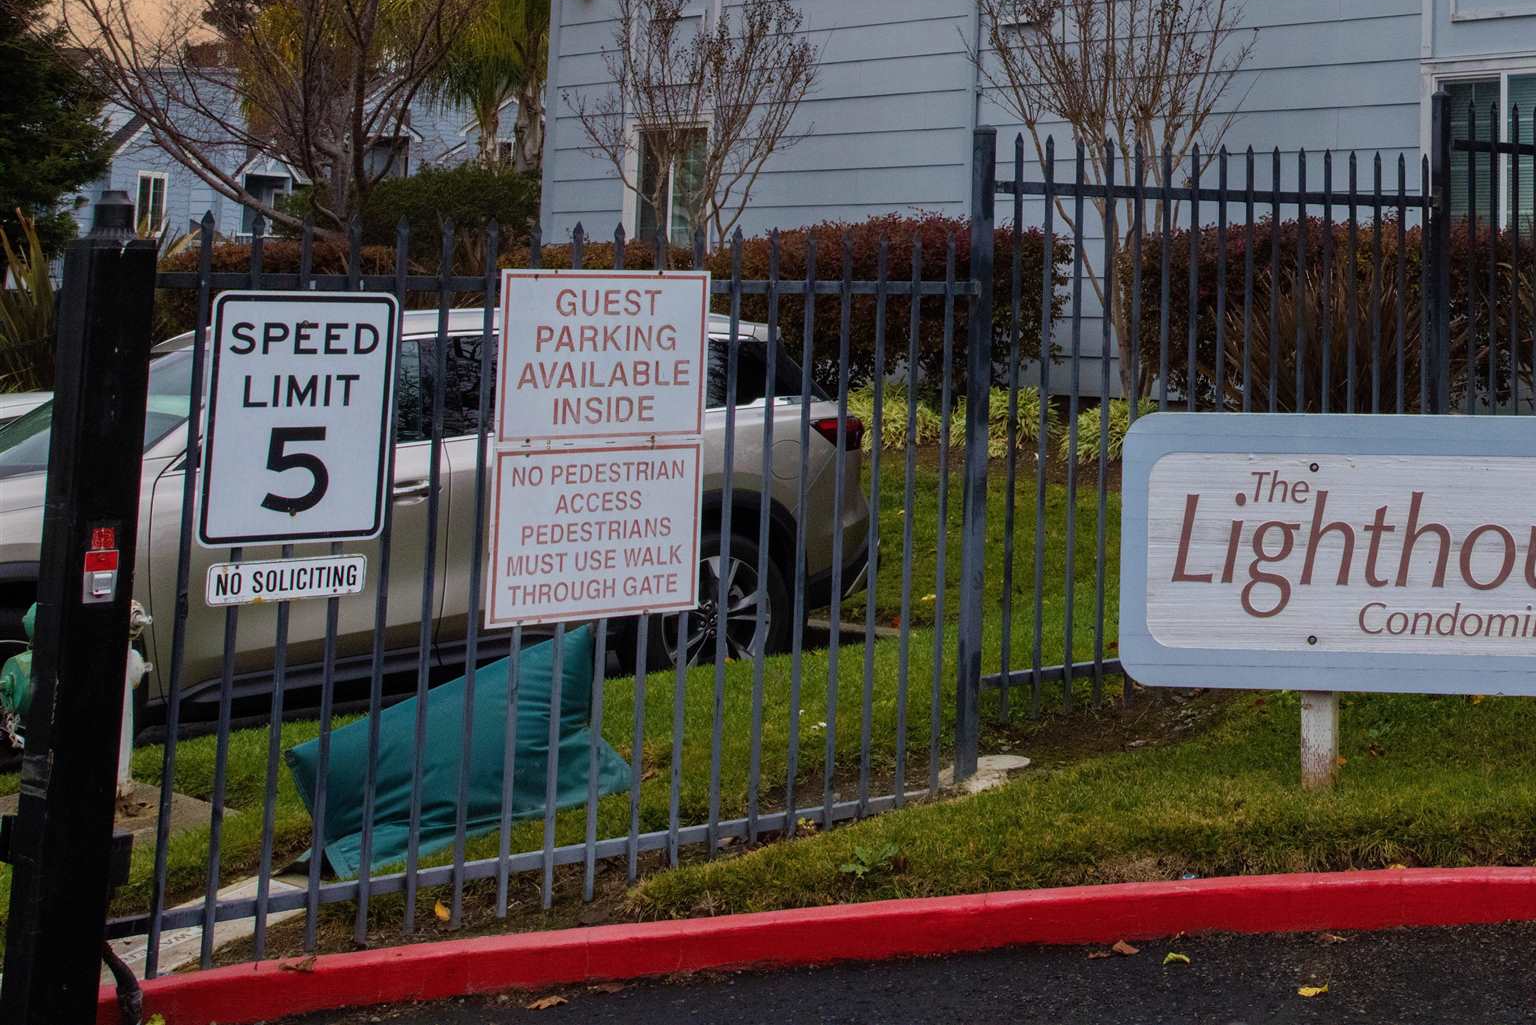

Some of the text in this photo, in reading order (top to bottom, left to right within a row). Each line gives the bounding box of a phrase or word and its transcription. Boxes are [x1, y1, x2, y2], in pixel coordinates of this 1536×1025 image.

[556, 288, 663, 317] GUEST
[229, 321, 380, 355] SPEED
[535, 324, 678, 353] PARKING
[516, 360, 691, 390] AVAILABLE
[243, 374, 360, 408] LIMIT
[552, 395, 656, 425] INSIDE
[260, 426, 329, 514] 5
[511, 459, 685, 488] NO PEDESTRIAN
[555, 490, 642, 515] ACCESS
[1251, 470, 1310, 504] The
[521, 517, 672, 546] PEDESTRIANS
[506, 544, 682, 577] MUST USE WALK
[216, 564, 358, 596] NO SOLICITING
[508, 573, 678, 606] THROUGH GATE
